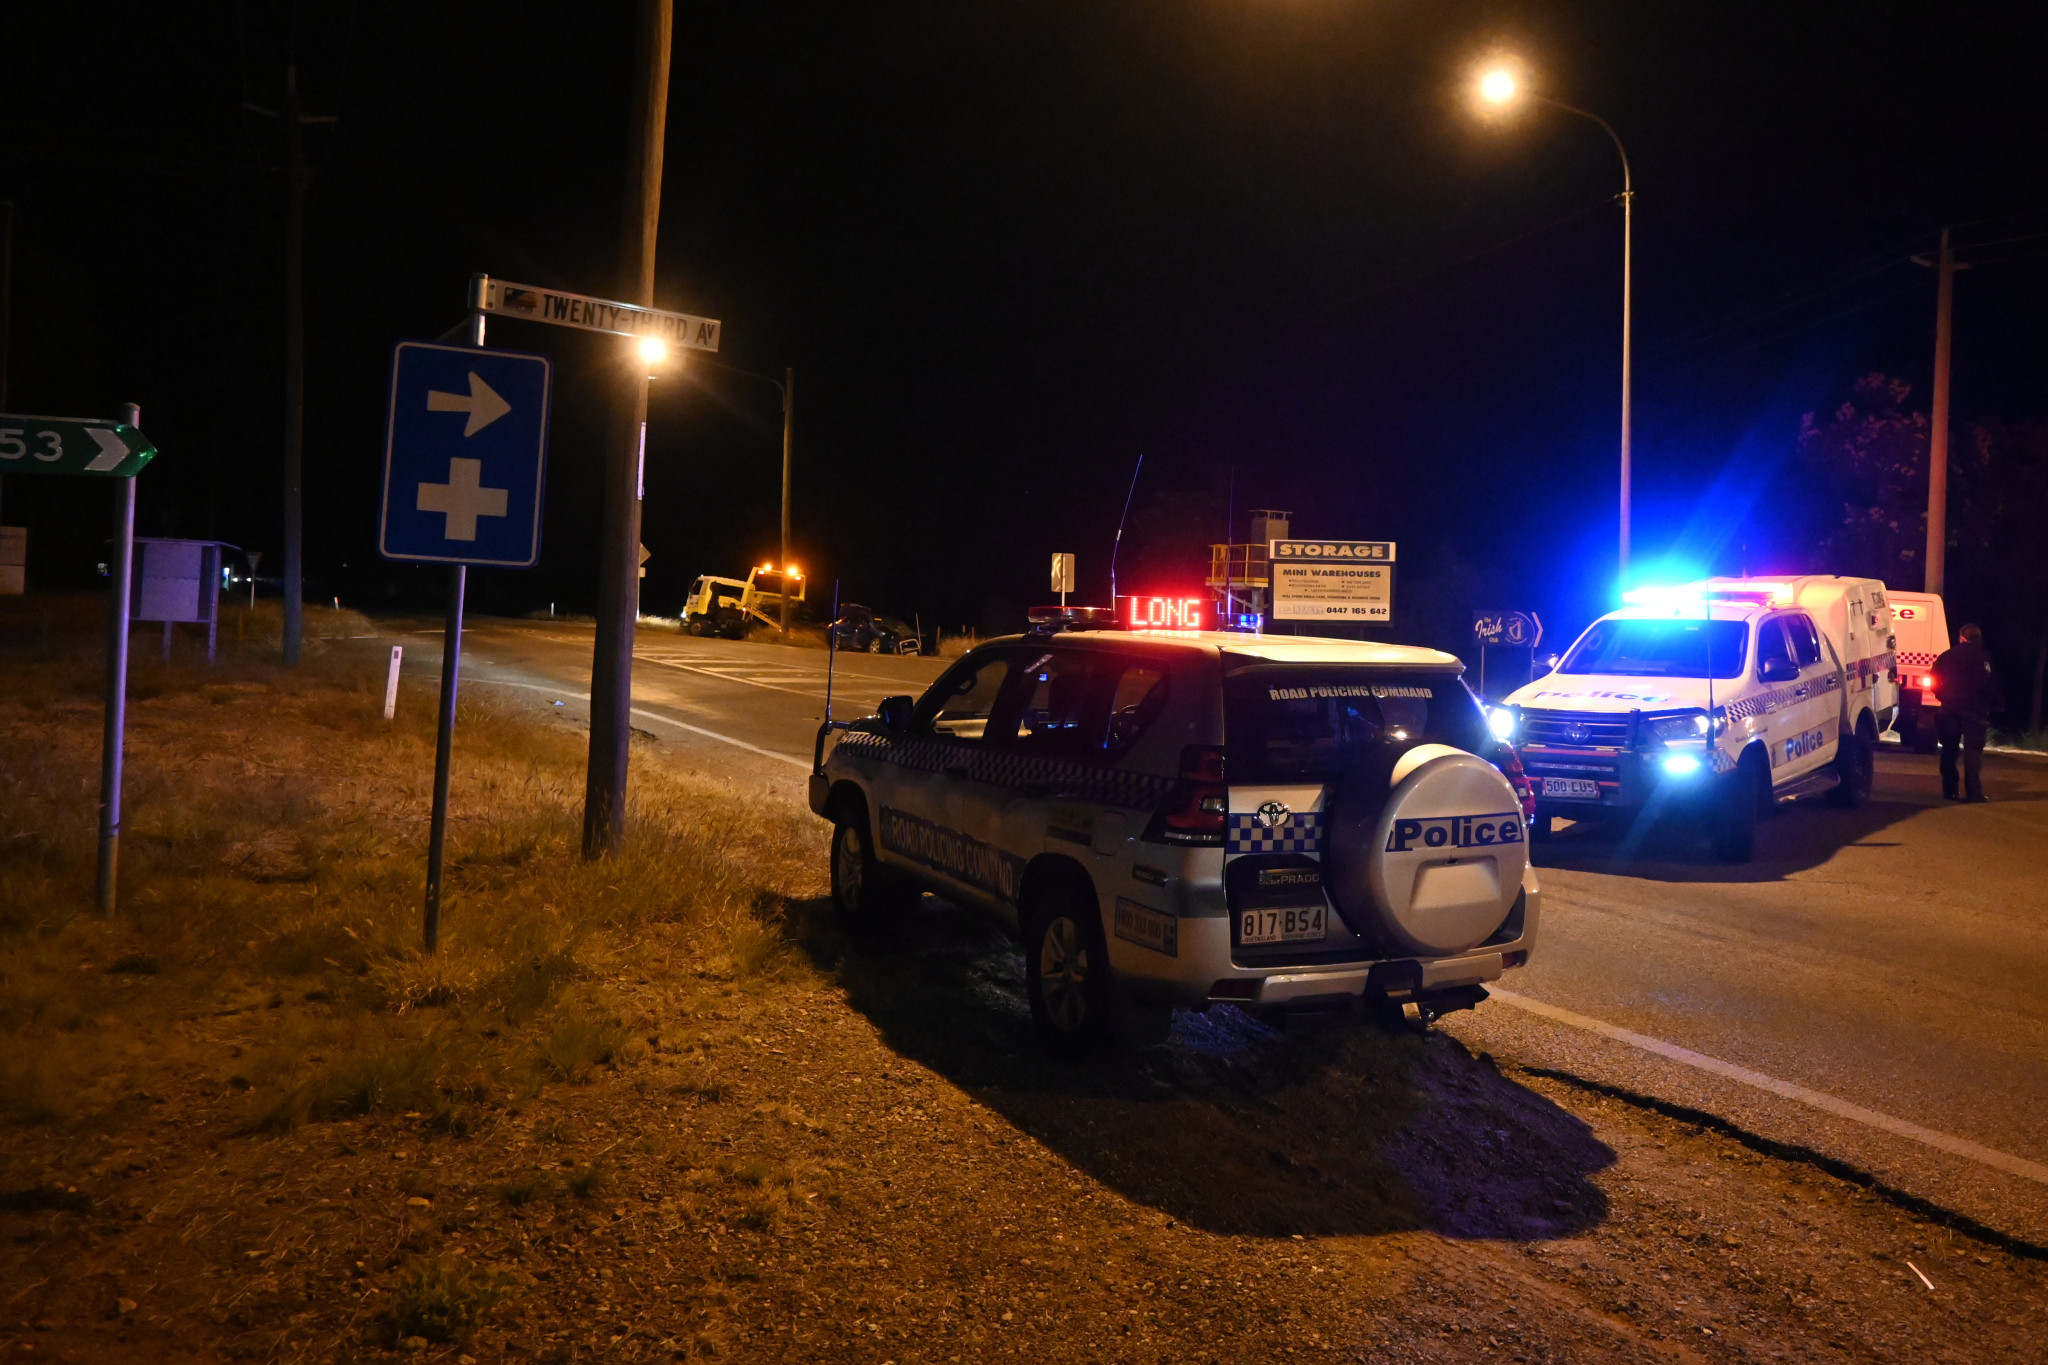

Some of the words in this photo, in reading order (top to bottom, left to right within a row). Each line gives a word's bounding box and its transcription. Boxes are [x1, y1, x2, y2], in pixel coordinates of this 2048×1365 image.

[696, 322, 715, 346] AV
[1280, 543, 1384, 558] STORAGE
[1311, 570, 1381, 578] WAREHOUSES
[1131, 597, 1201, 627] LONG
[1326, 606, 1348, 614] 0447
[1352, 607, 1367, 615] 165
[1475, 616, 1504, 639] Irish
[1269, 687, 1309, 701] ROAD
[1309, 685, 1370, 698] POLICING
[1371, 686, 1433, 699] COMMAND
[1786, 730, 1823, 761] Police
[891, 814, 918, 853] ROAD
[918, 825, 965, 873] POLICING
[1395, 817, 1518, 851] Police
[1280, 873, 1320, 884] PRADO
